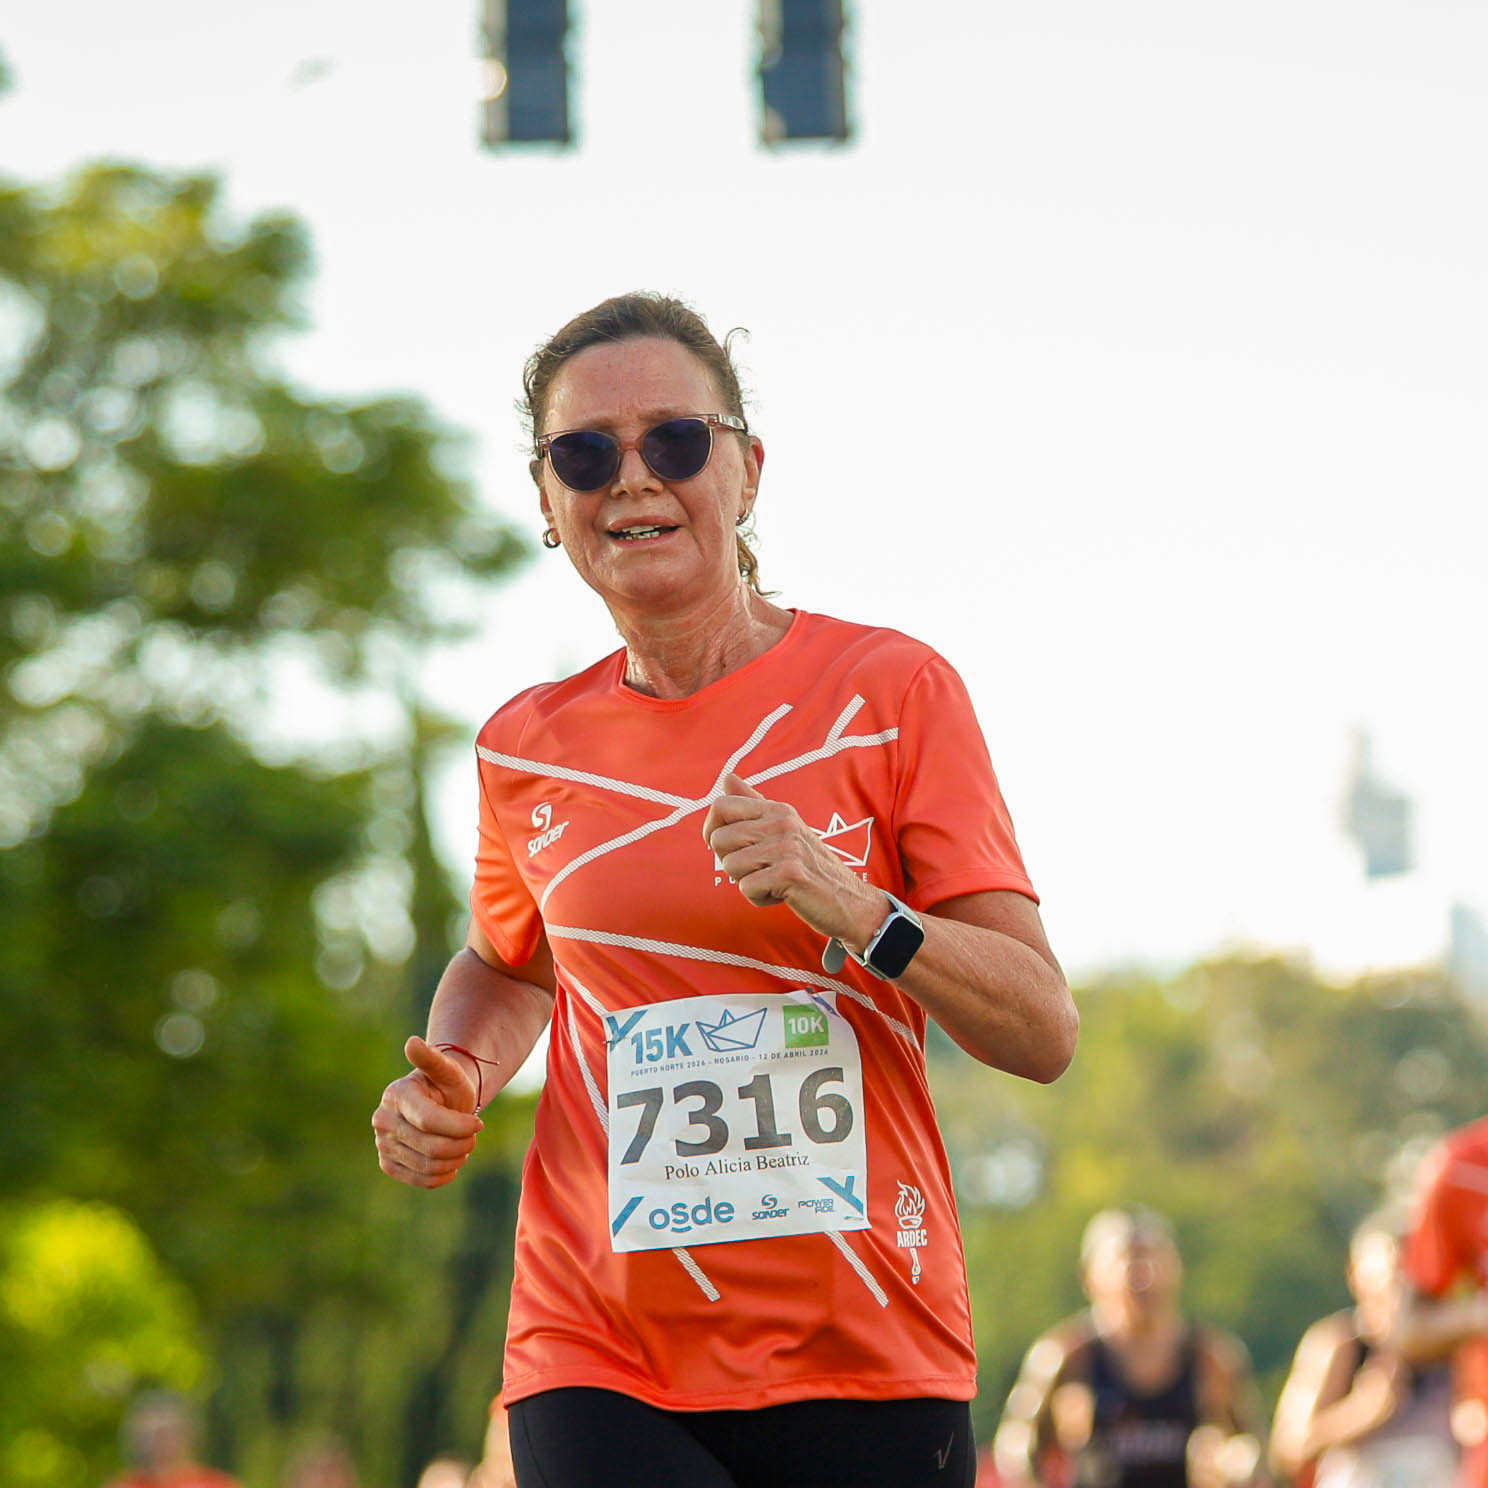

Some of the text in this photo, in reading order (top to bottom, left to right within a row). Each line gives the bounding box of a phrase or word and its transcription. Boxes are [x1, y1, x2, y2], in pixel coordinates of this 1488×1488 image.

[787, 1016, 825, 1036] 10K
[631, 1023, 693, 1065] 15K
[631, 1067, 658, 1077] PUERTO
[660, 1063, 684, 1072] NORTE
[714, 1054, 749, 1065] ROSARIO
[772, 1052, 781, 1060] DE
[784, 1049, 806, 1058] ABRIL
[616, 1066, 854, 1166] 7316
[664, 1152, 810, 1180] Polo Alicia Beatriz
[649, 1196, 735, 1231] osde
[896, 1229, 928, 1248] ARDEC
